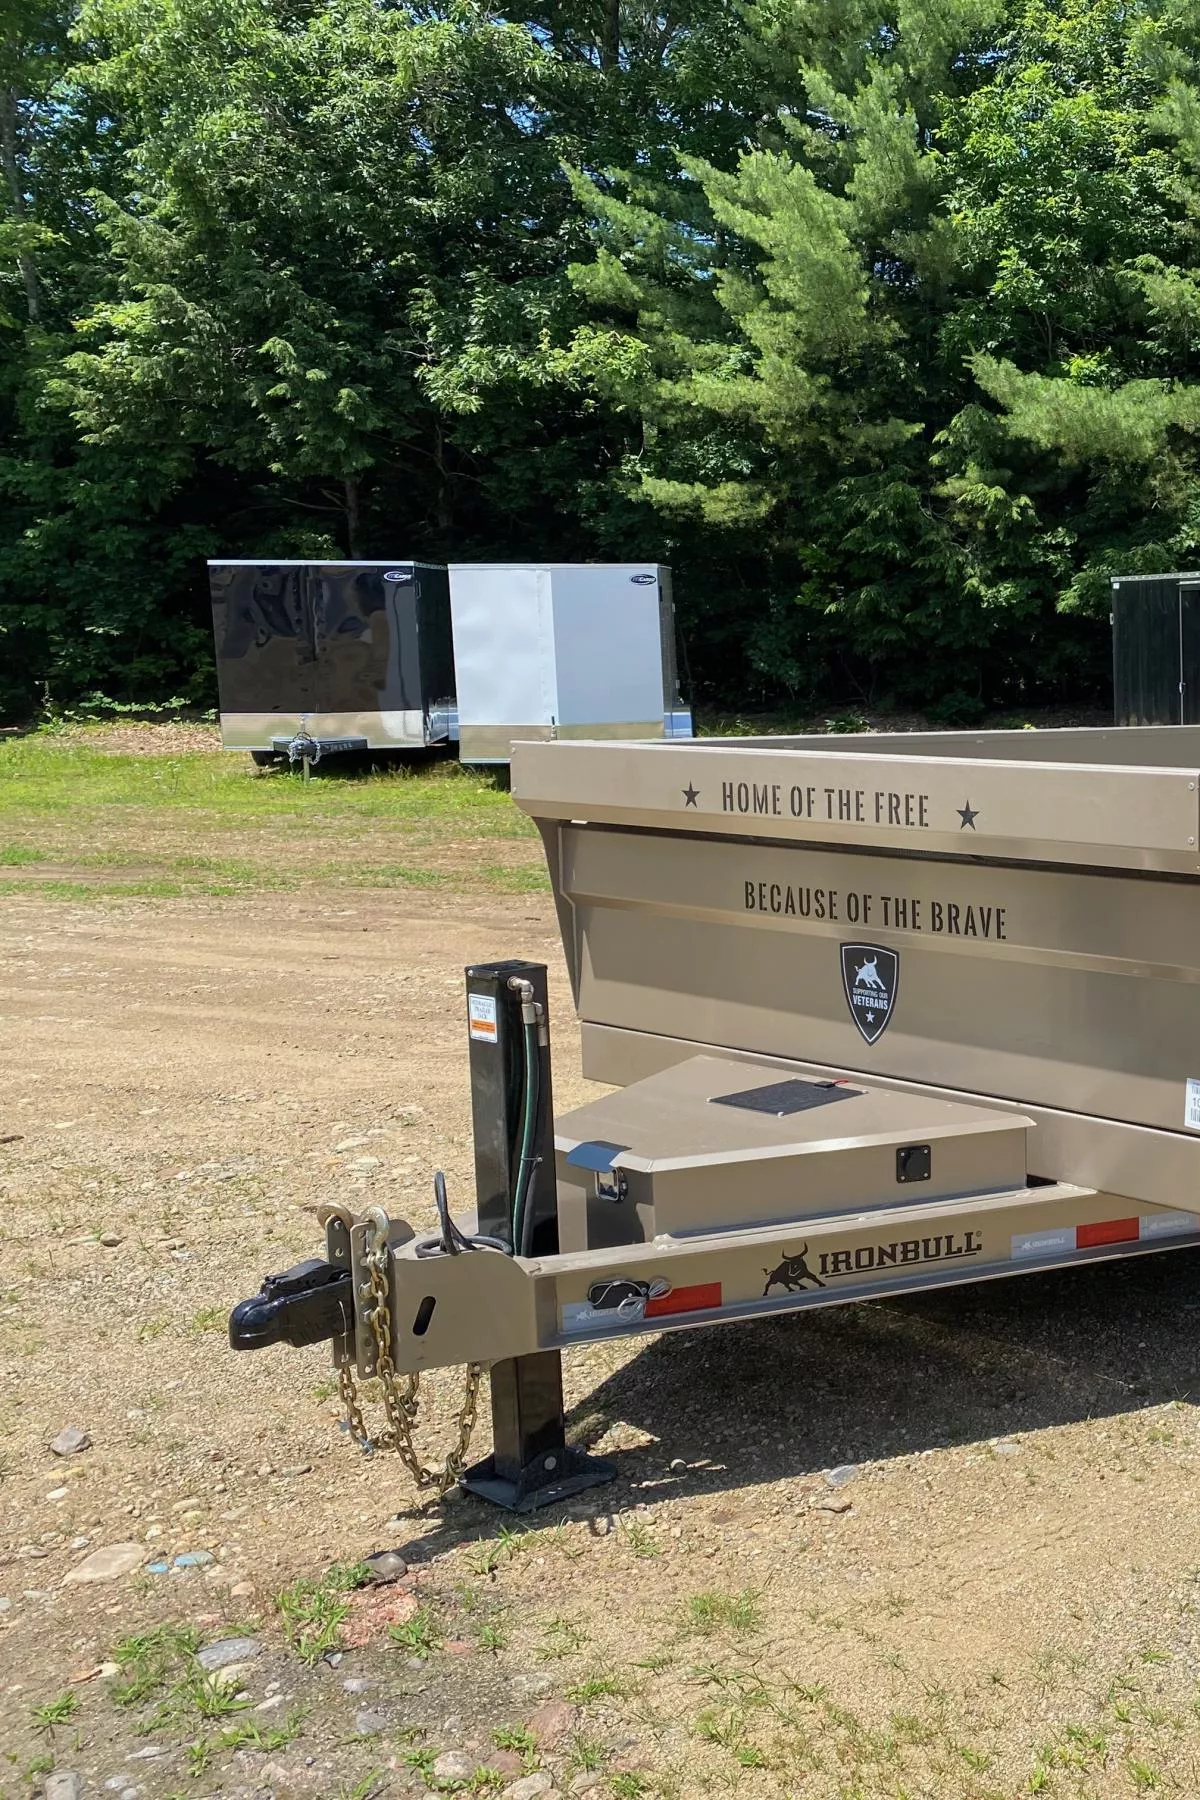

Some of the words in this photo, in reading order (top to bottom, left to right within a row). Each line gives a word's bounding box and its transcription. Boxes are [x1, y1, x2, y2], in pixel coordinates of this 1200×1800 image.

[722, 781, 782, 815] HOME
[789, 785, 816, 818] OF
[824, 788, 865, 822] THE
[874, 791, 929, 828] FREE
[744, 880, 838, 920] BECAUSE
[846, 892, 873, 924] OF
[880, 896, 922, 930] THE
[931, 901, 1007, 940] BRAVE
[852, 994, 888, 1010] VETERANS
[819, 1231, 983, 1275] IRONBULL
